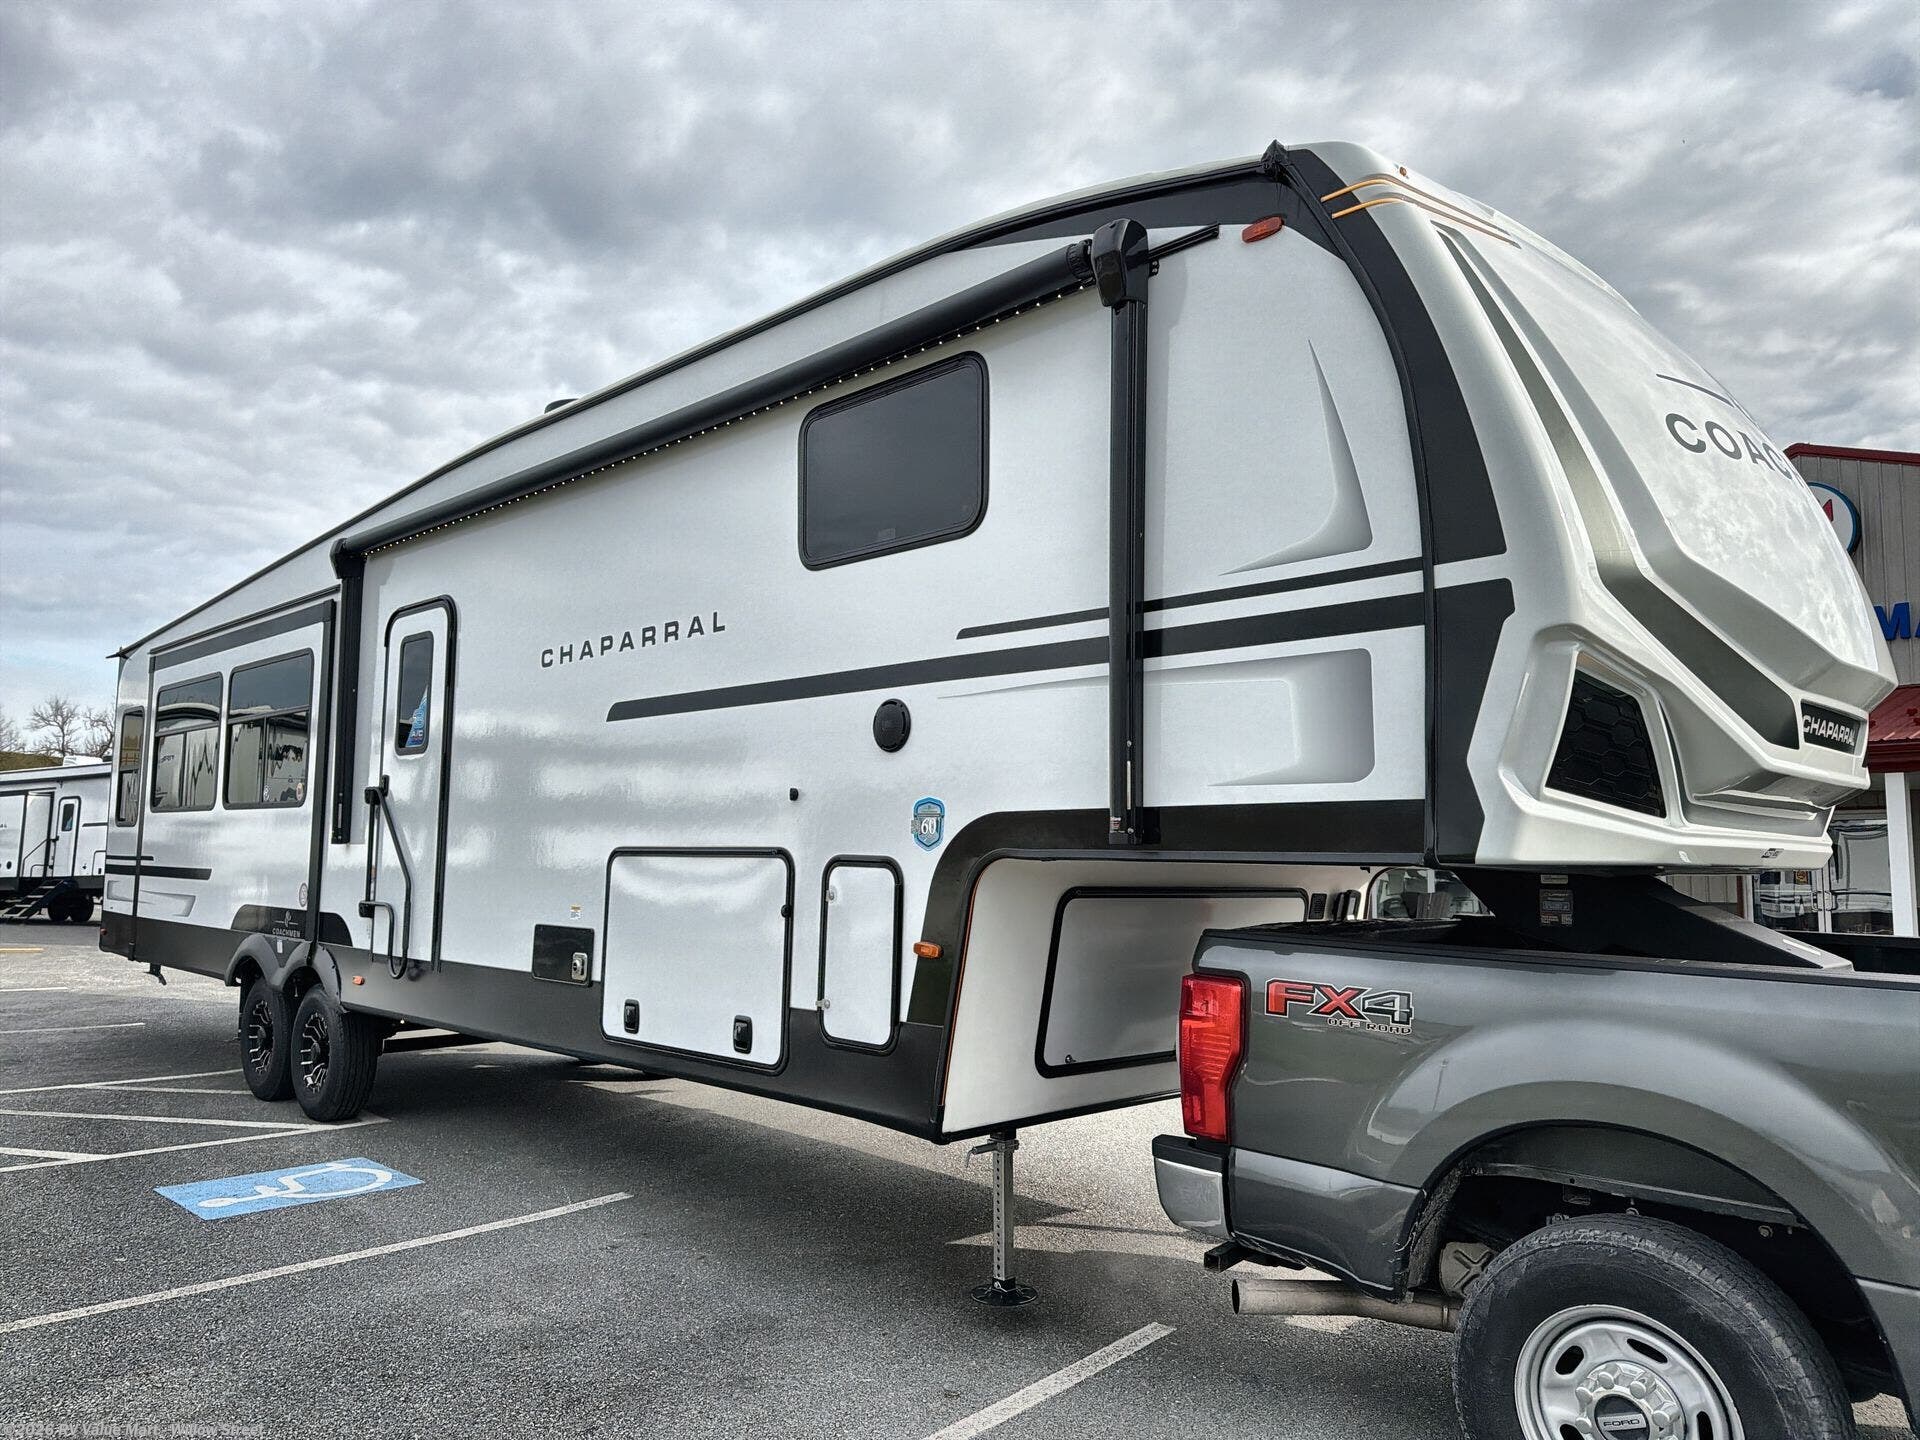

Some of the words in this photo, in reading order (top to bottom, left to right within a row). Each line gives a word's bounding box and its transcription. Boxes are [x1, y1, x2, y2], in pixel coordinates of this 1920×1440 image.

[1665, 413, 1804, 488] COAC
[1874, 602, 1920, 641] M
[541, 611, 726, 668] CHAPARRAL
[921, 817, 937, 835] 60
[271, 928, 301, 938] COACHMEN
[1265, 977, 1414, 1026] FX4
[1327, 1017, 1361, 1029] OFF
[1365, 1021, 1413, 1036] ROAD
[1603, 1418, 1640, 1427] FORD
